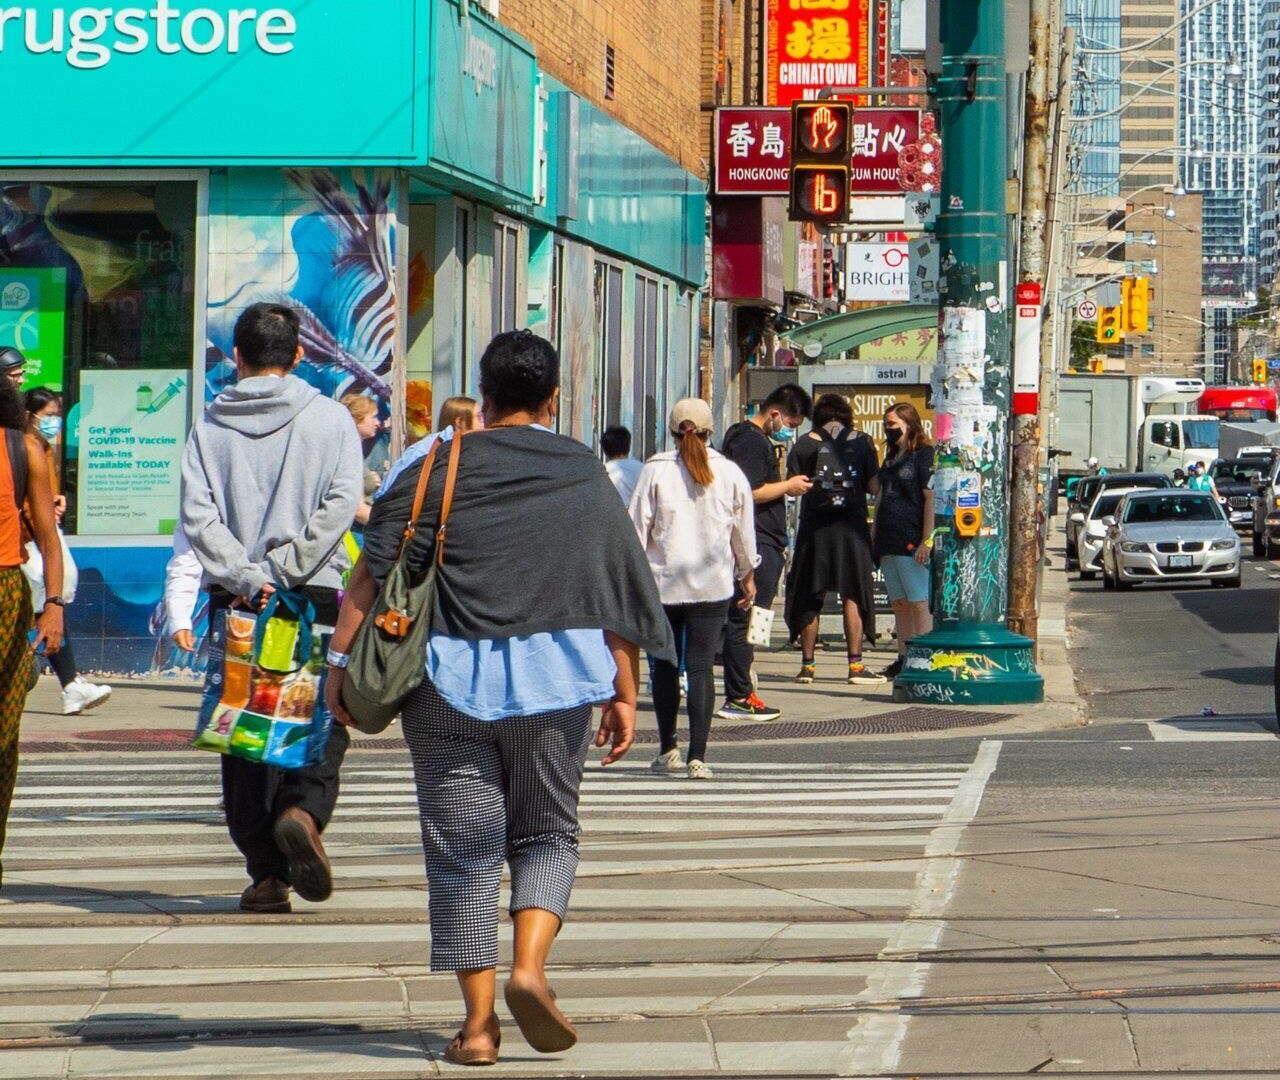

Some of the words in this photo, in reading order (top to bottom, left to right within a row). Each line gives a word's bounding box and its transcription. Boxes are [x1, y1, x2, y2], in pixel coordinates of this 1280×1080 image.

[780, 62, 857, 86] CHINATOWN
[729, 167, 788, 181] HONGKONG
[873, 167, 899, 180] HOUS
[877, 369, 907, 379] astral
[88, 426, 107, 435] Get
[110, 427, 132, 436] your
[88, 436, 135, 445] COVID-19
[138, 436, 177, 445] Vaccine
[88, 461, 133, 470] available
[136, 460, 170, 469] TODAY
